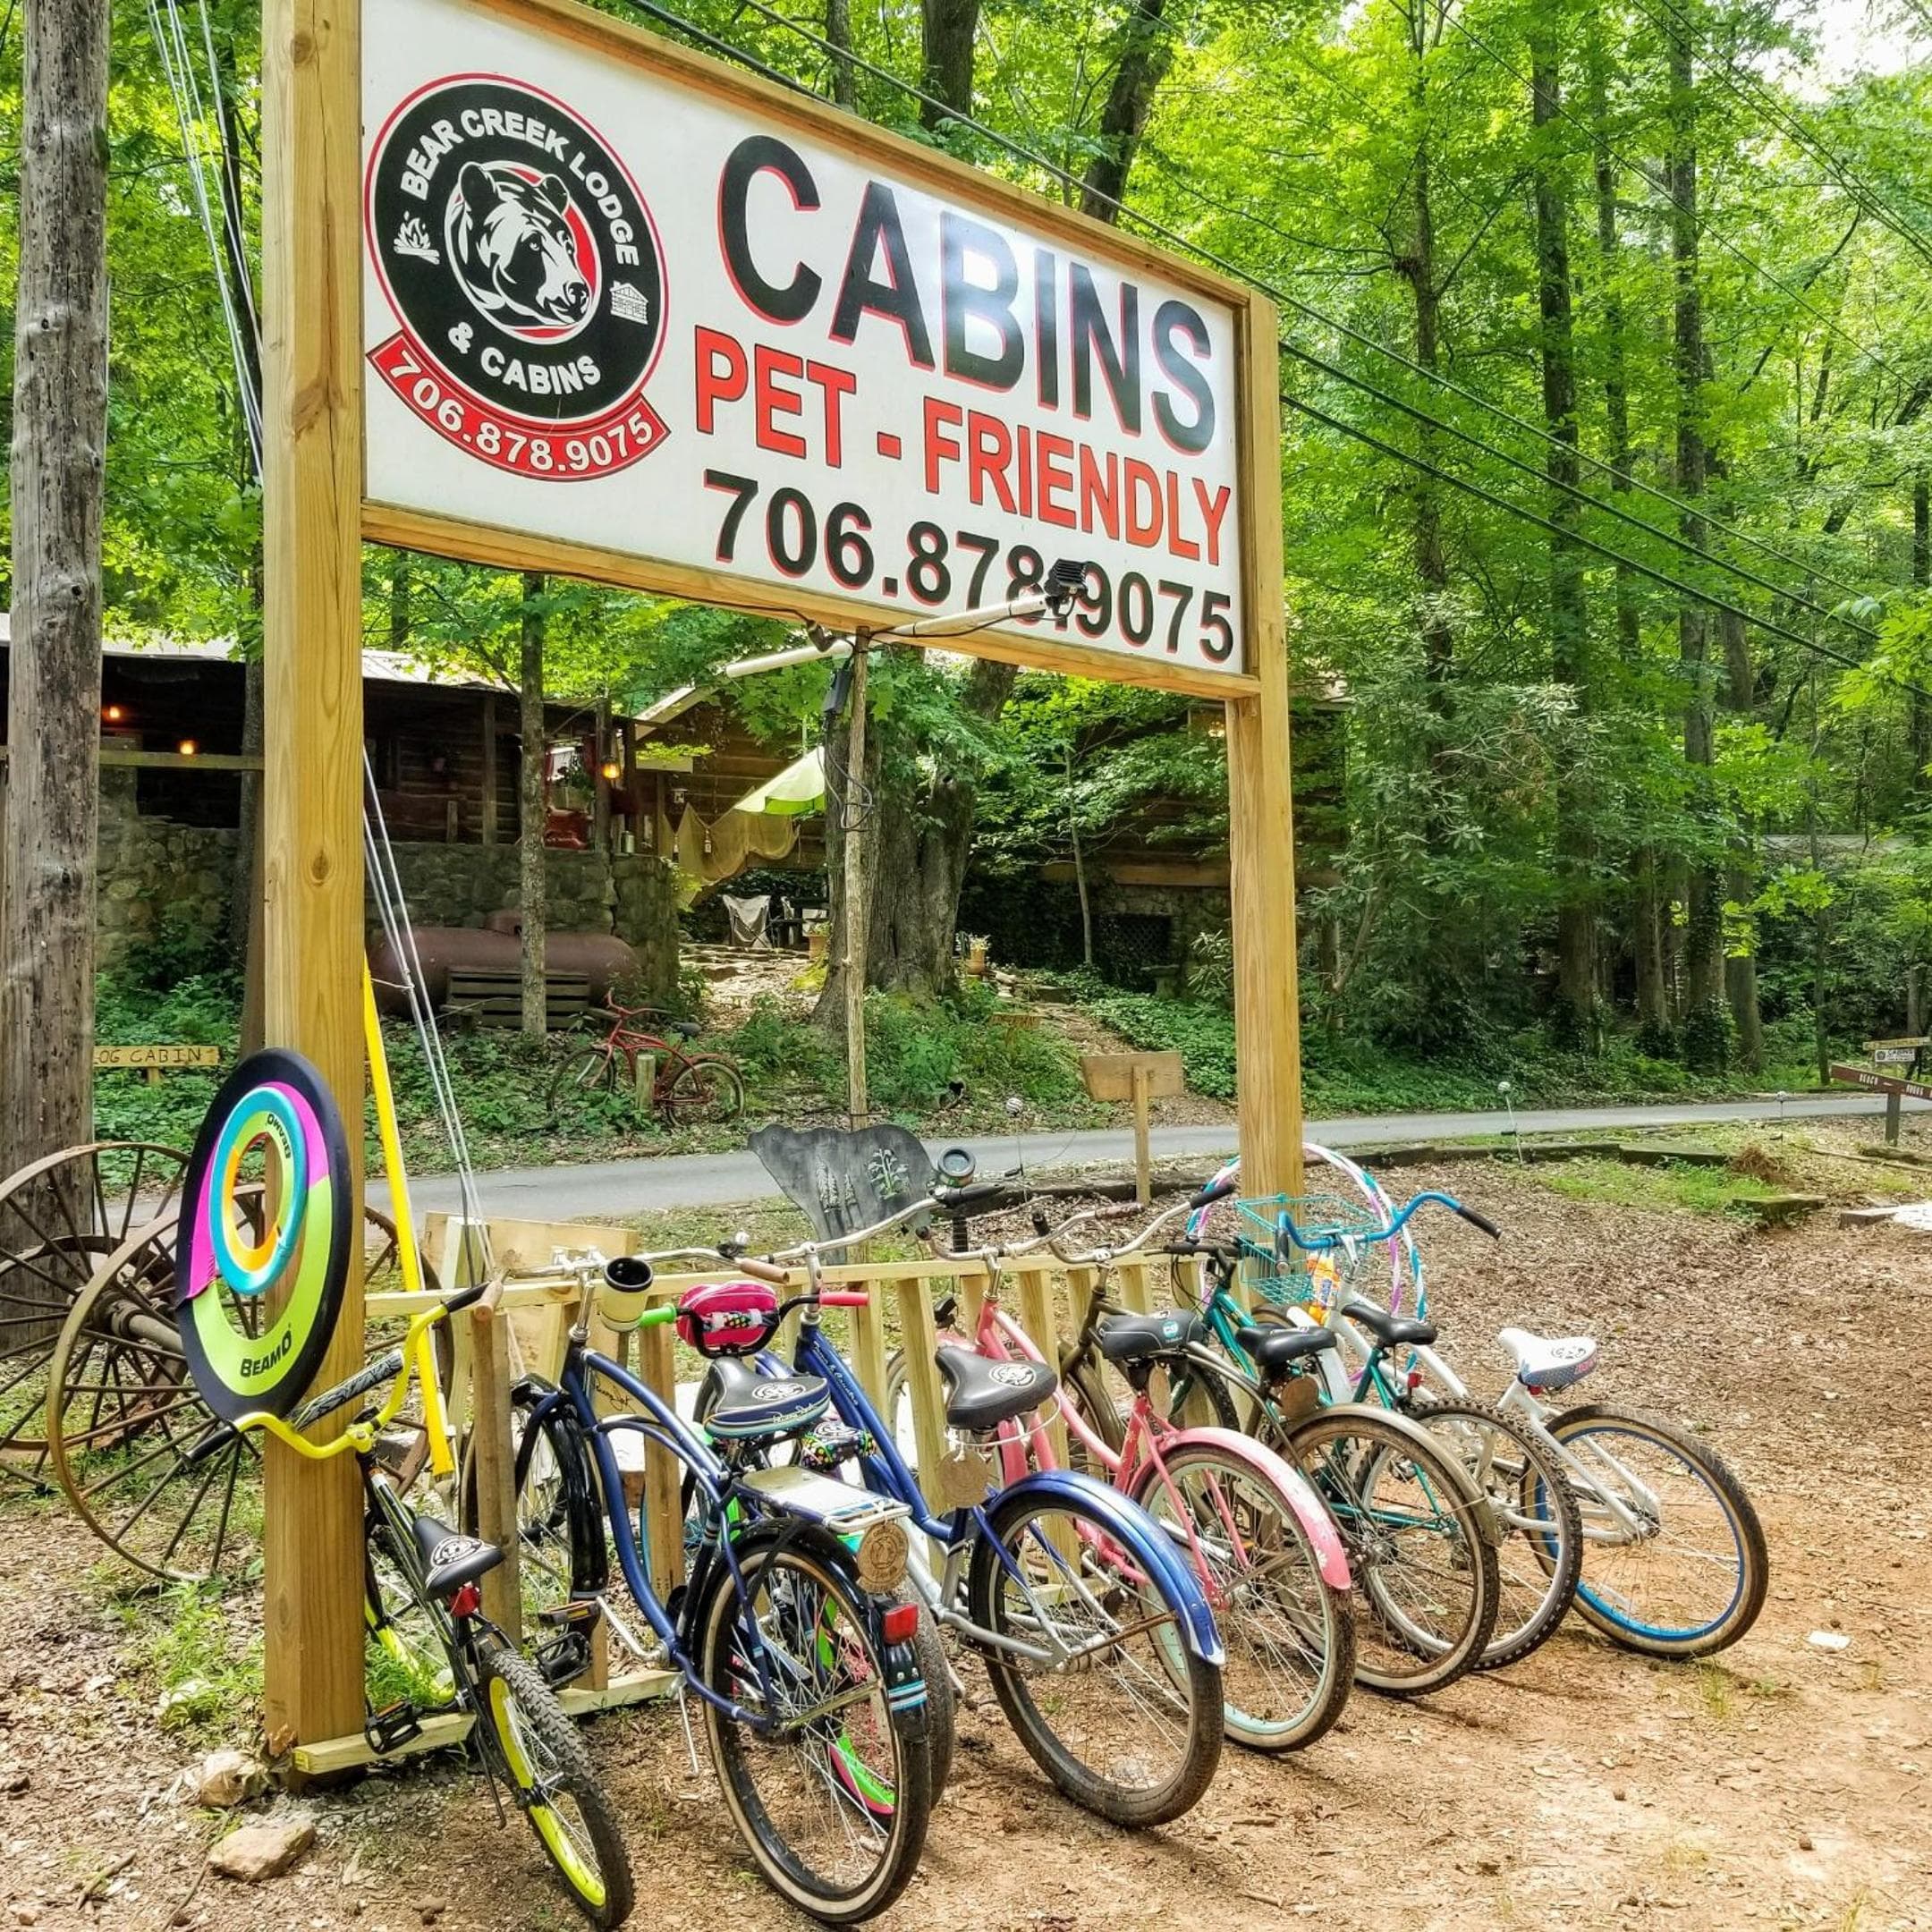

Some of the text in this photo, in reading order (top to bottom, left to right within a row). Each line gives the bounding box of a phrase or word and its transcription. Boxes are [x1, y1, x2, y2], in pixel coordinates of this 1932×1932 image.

[401, 108, 640, 267] BEAR CREEK LODGE
[717, 135, 1215, 455] CABINS
[390, 350, 652, 471] 706.878.9075
[448, 322, 600, 394] & CABINS
[695, 325, 856, 468] PET
[923, 396, 1231, 566] FRIENDLY
[130, 1047, 200, 1063] CABIN
[241, 1330, 292, 1377] BEAMO
